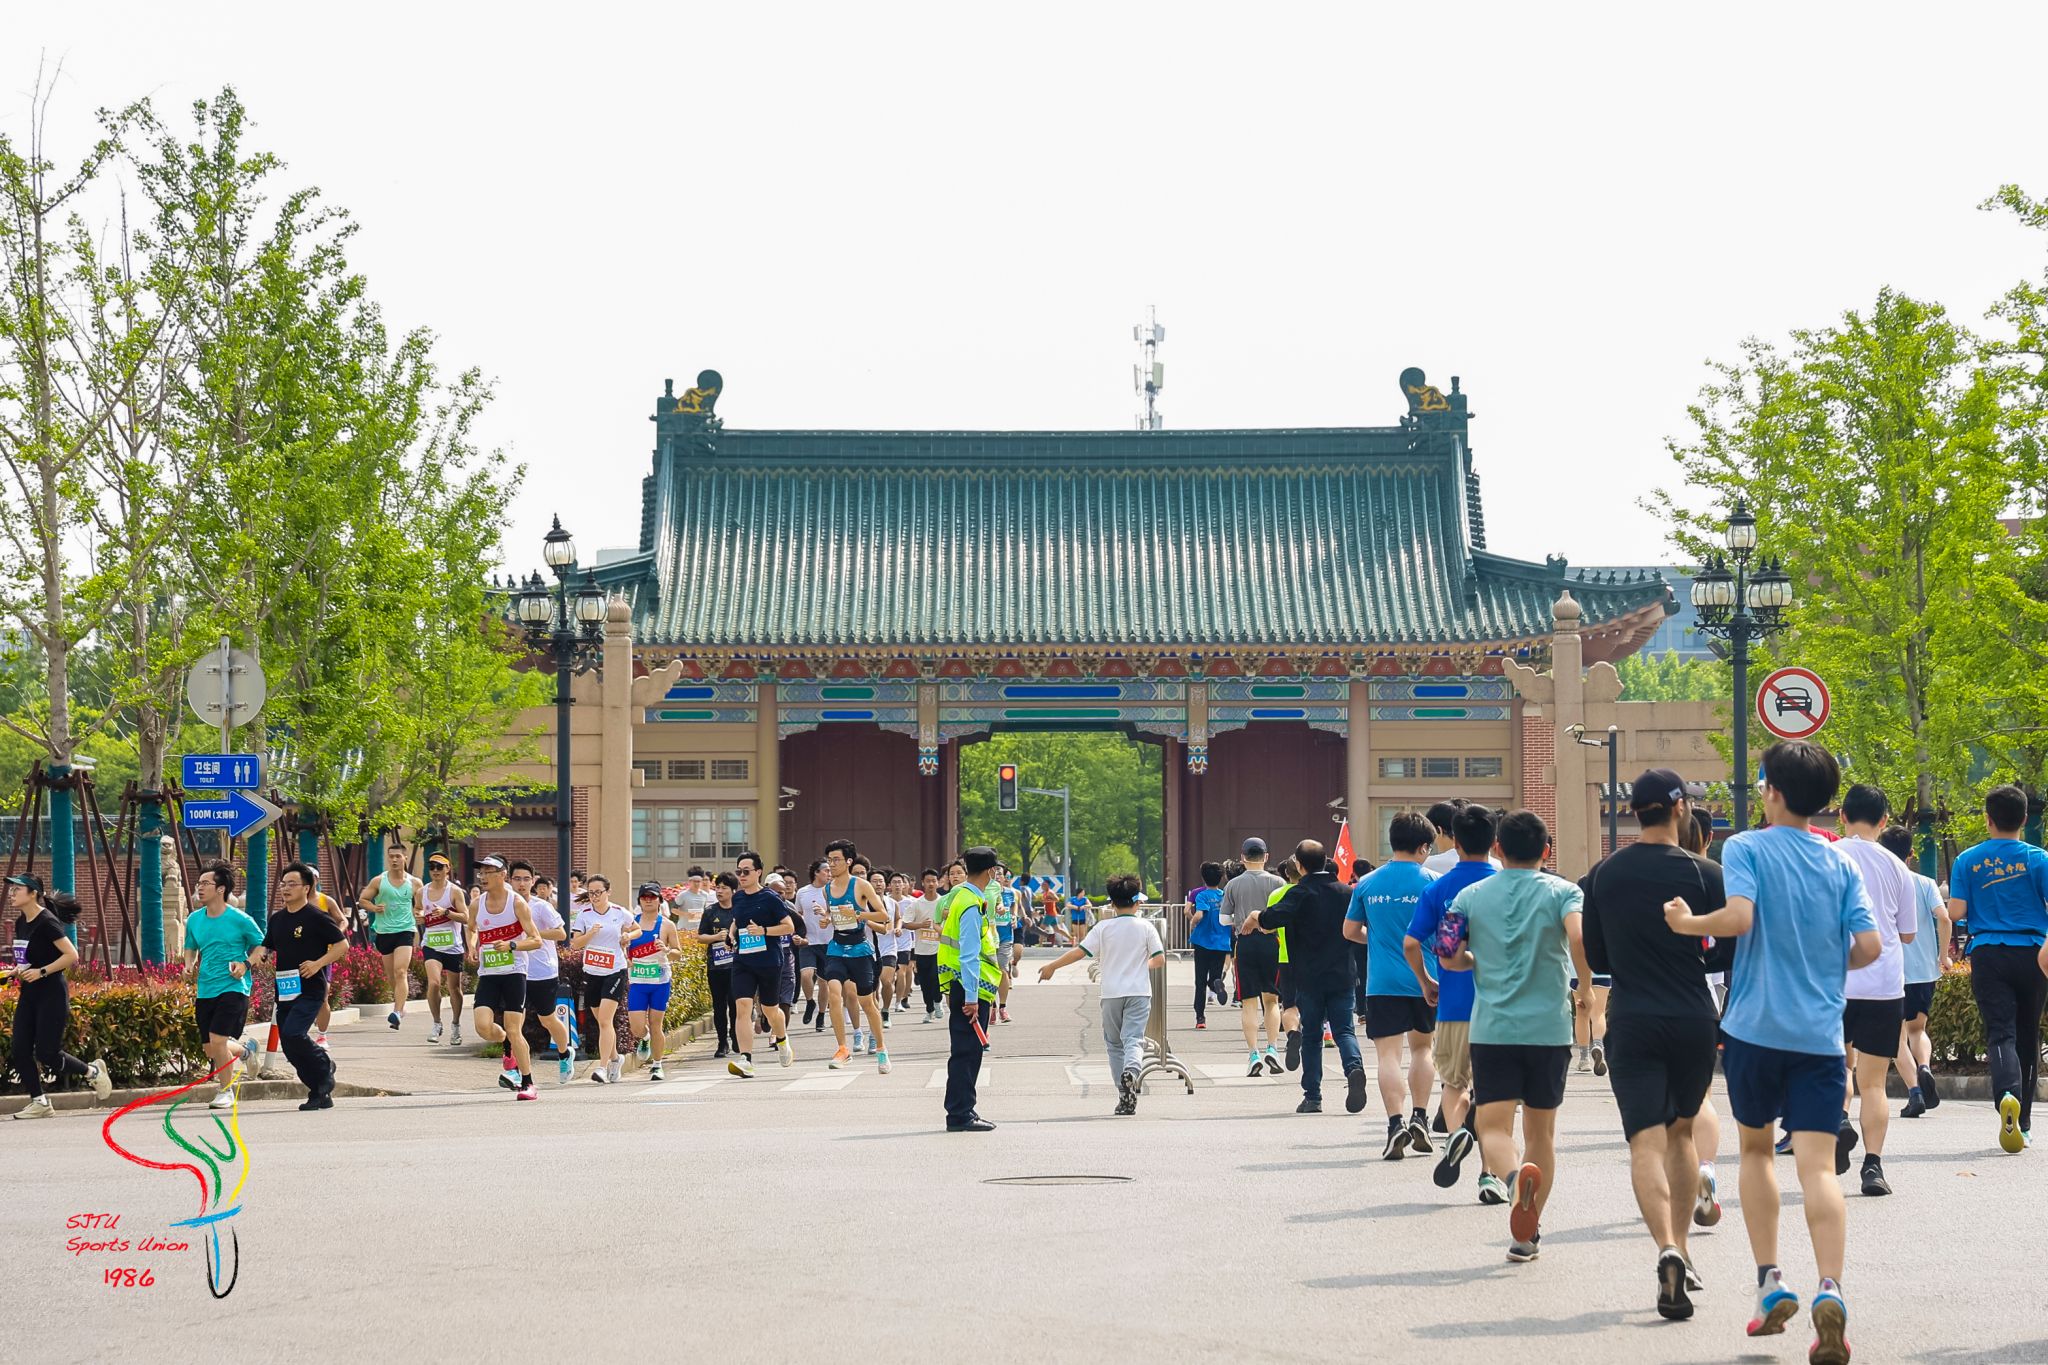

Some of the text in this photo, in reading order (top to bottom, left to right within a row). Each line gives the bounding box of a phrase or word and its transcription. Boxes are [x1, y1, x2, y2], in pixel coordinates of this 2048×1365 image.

[194, 761, 220, 774] 卫生间
[189, 809, 212, 819] 100M
[429, 934, 451, 944] K018
[484, 952, 510, 963] K015
[588, 953, 611, 965] D021
[633, 966, 657, 976] H015
